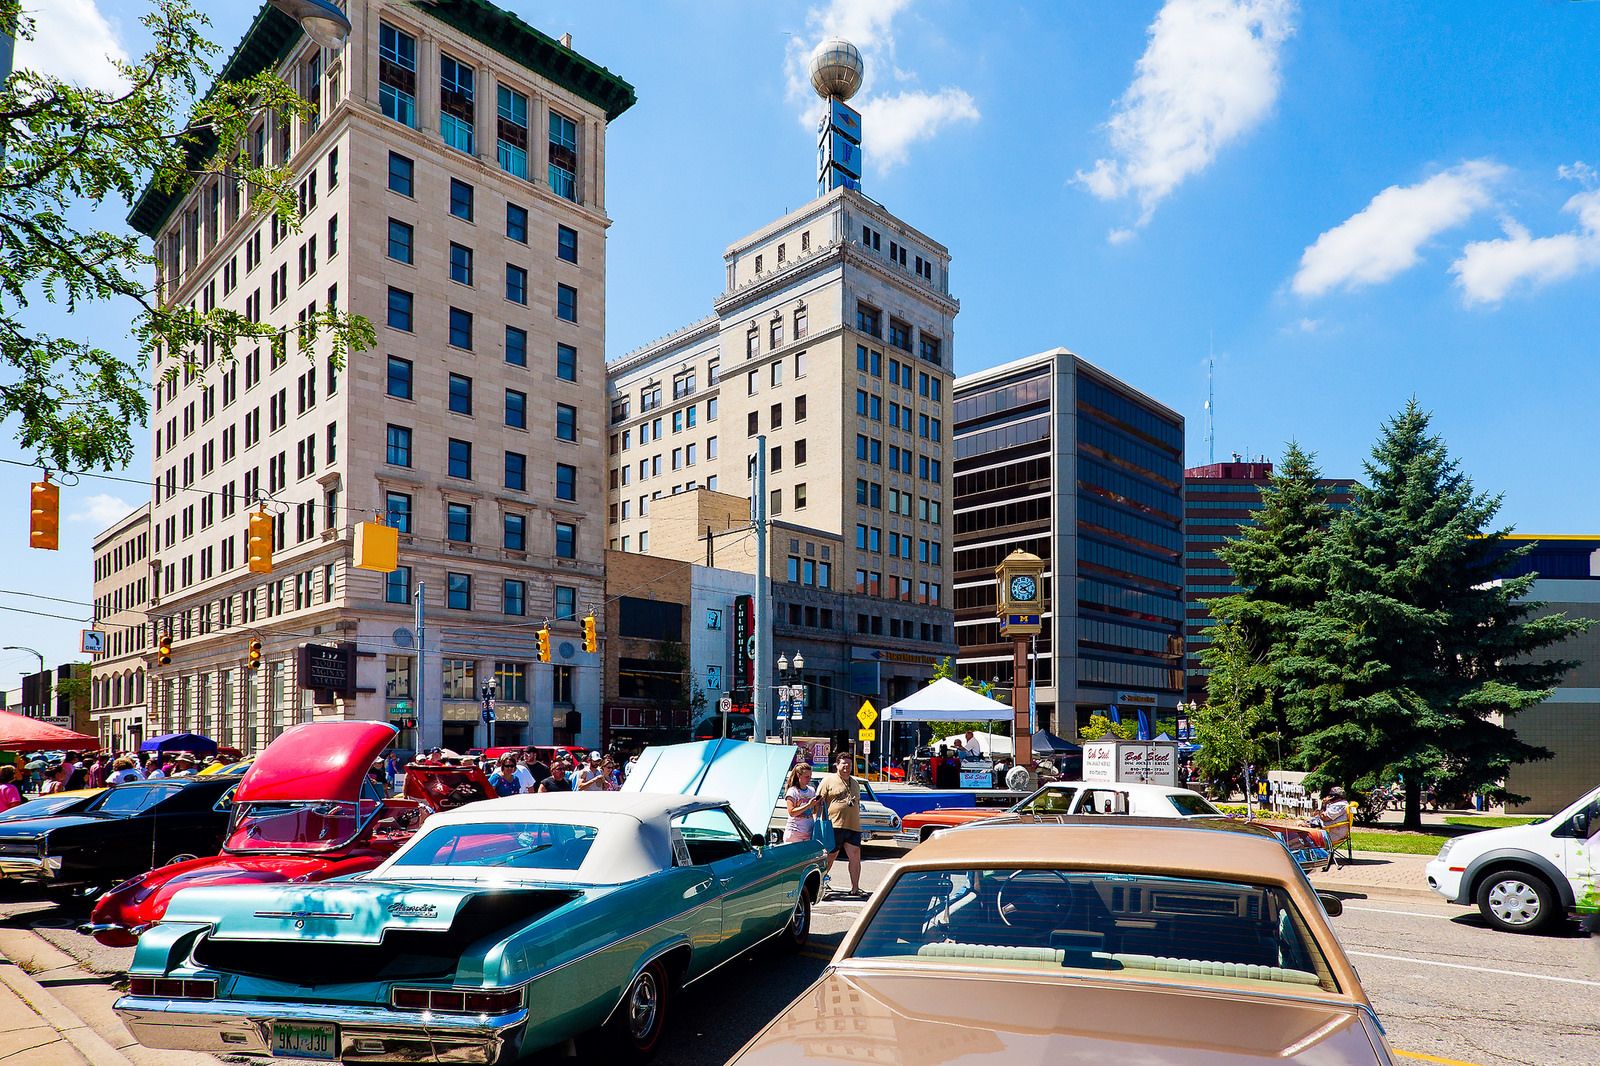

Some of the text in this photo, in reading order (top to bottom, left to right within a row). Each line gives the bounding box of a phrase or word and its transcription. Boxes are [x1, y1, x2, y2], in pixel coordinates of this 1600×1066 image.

[1087, 748, 1110, 759] Bob Steel
[1124, 751, 1170, 761] Bob Steel
[279, 1031, 300, 1050] 9KJ
